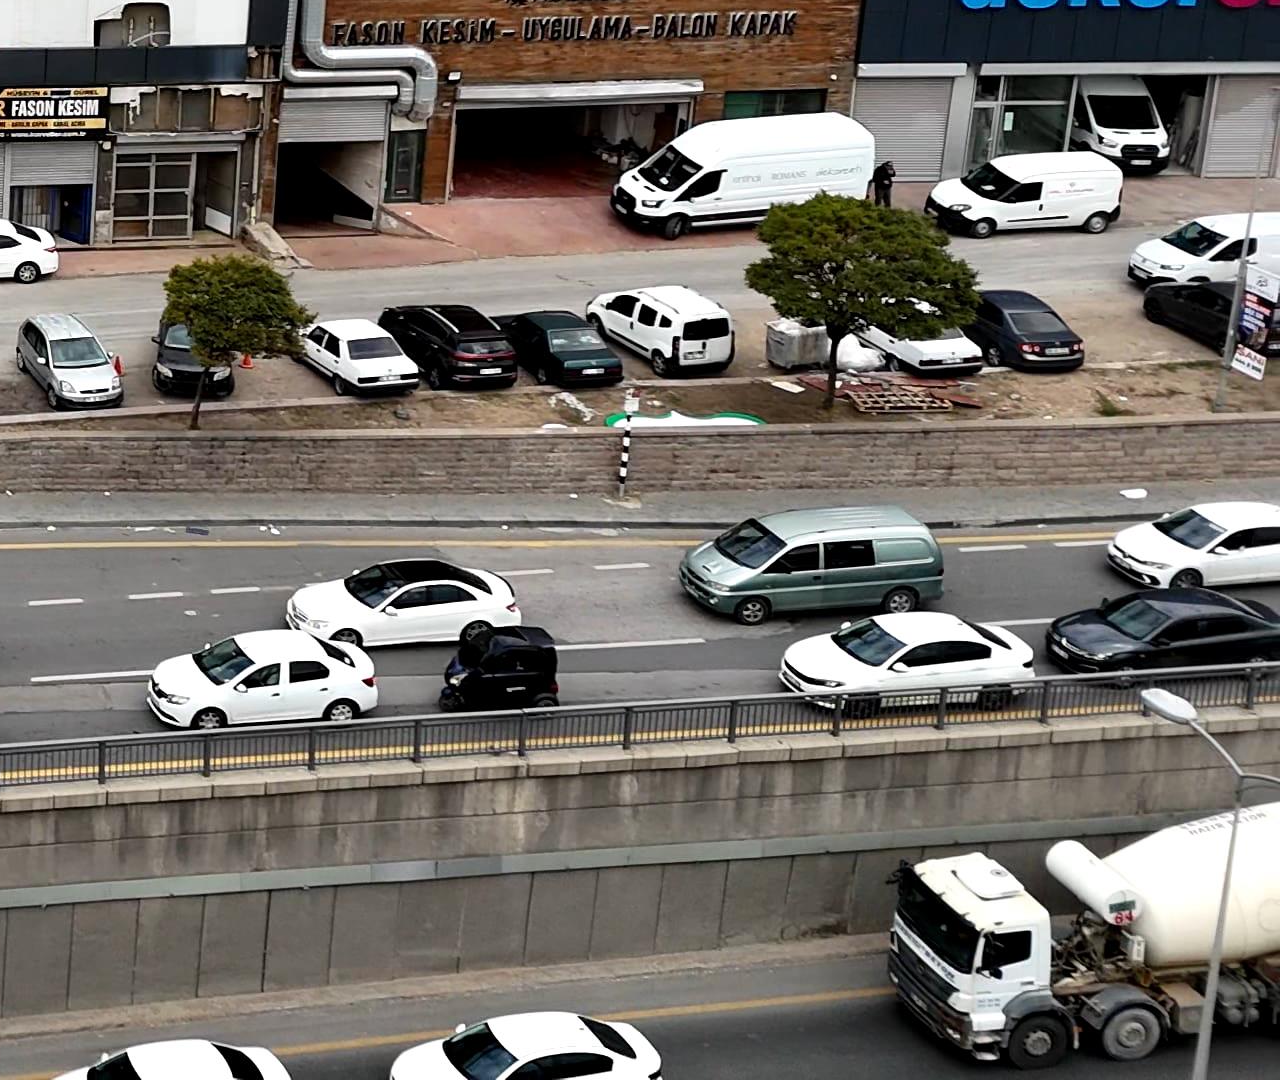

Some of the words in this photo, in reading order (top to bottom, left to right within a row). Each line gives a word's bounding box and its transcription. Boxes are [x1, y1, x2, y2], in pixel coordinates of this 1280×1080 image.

[332, 21, 405, 46] FASON
[651, 13, 717, 39] BALON
[727, 10, 798, 36] KAPAK
[12, 101, 54, 116] FASON
